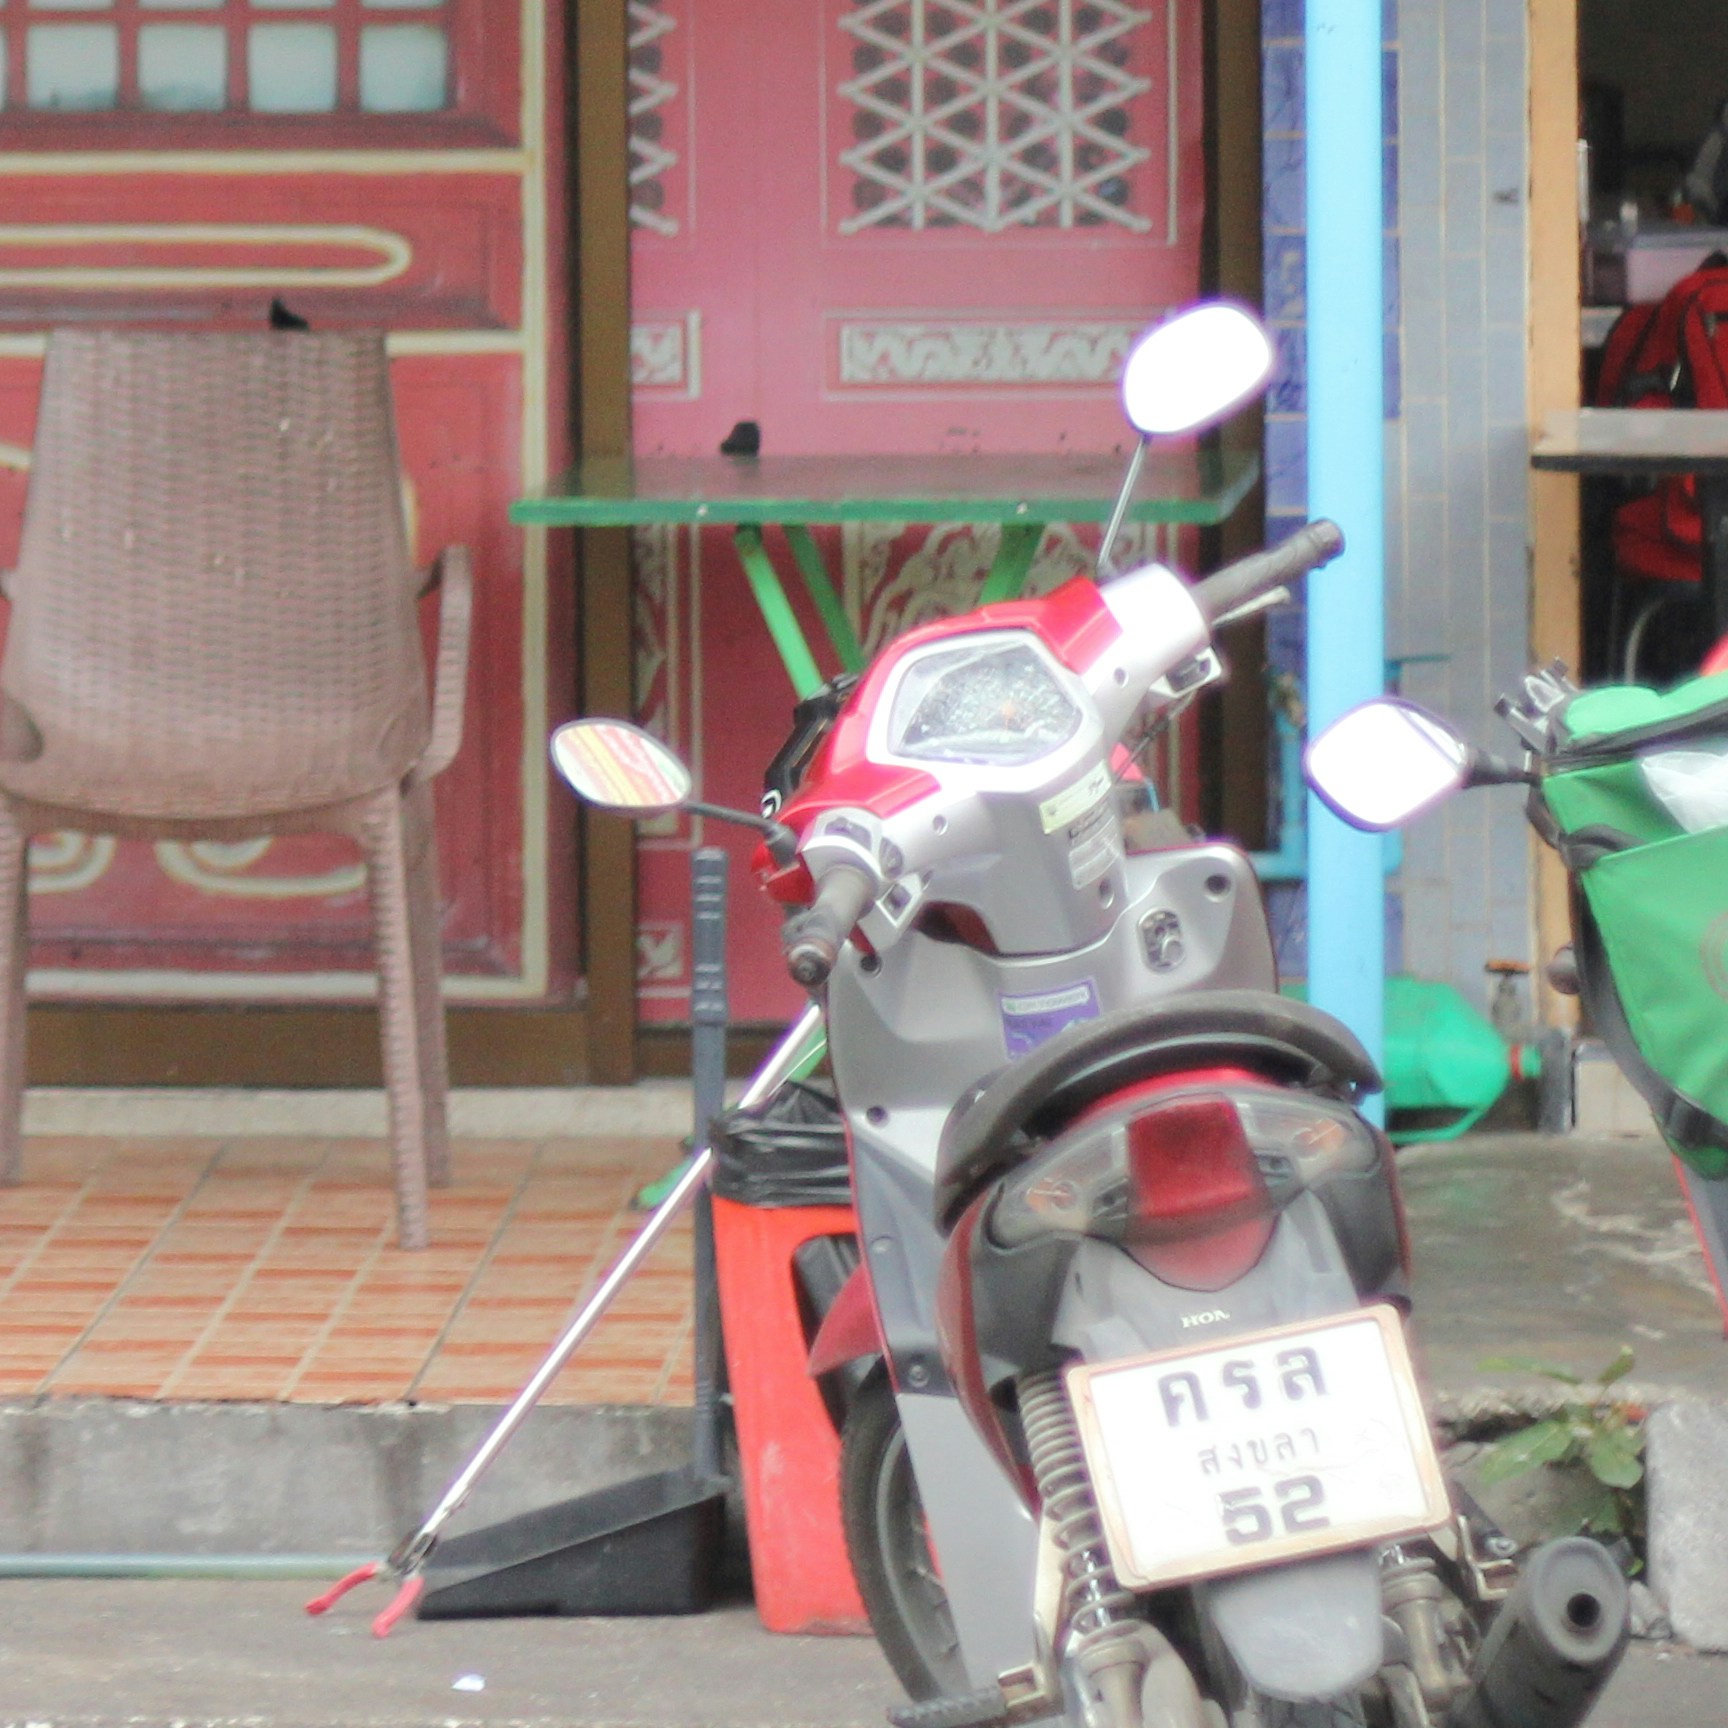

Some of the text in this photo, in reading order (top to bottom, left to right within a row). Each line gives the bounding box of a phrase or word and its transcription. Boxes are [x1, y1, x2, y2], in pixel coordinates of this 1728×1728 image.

[1159, 1347, 1328, 1426] ครล
[1198, 1428, 1320, 1475] สงขลา
[1218, 1475, 1330, 1544] 52
